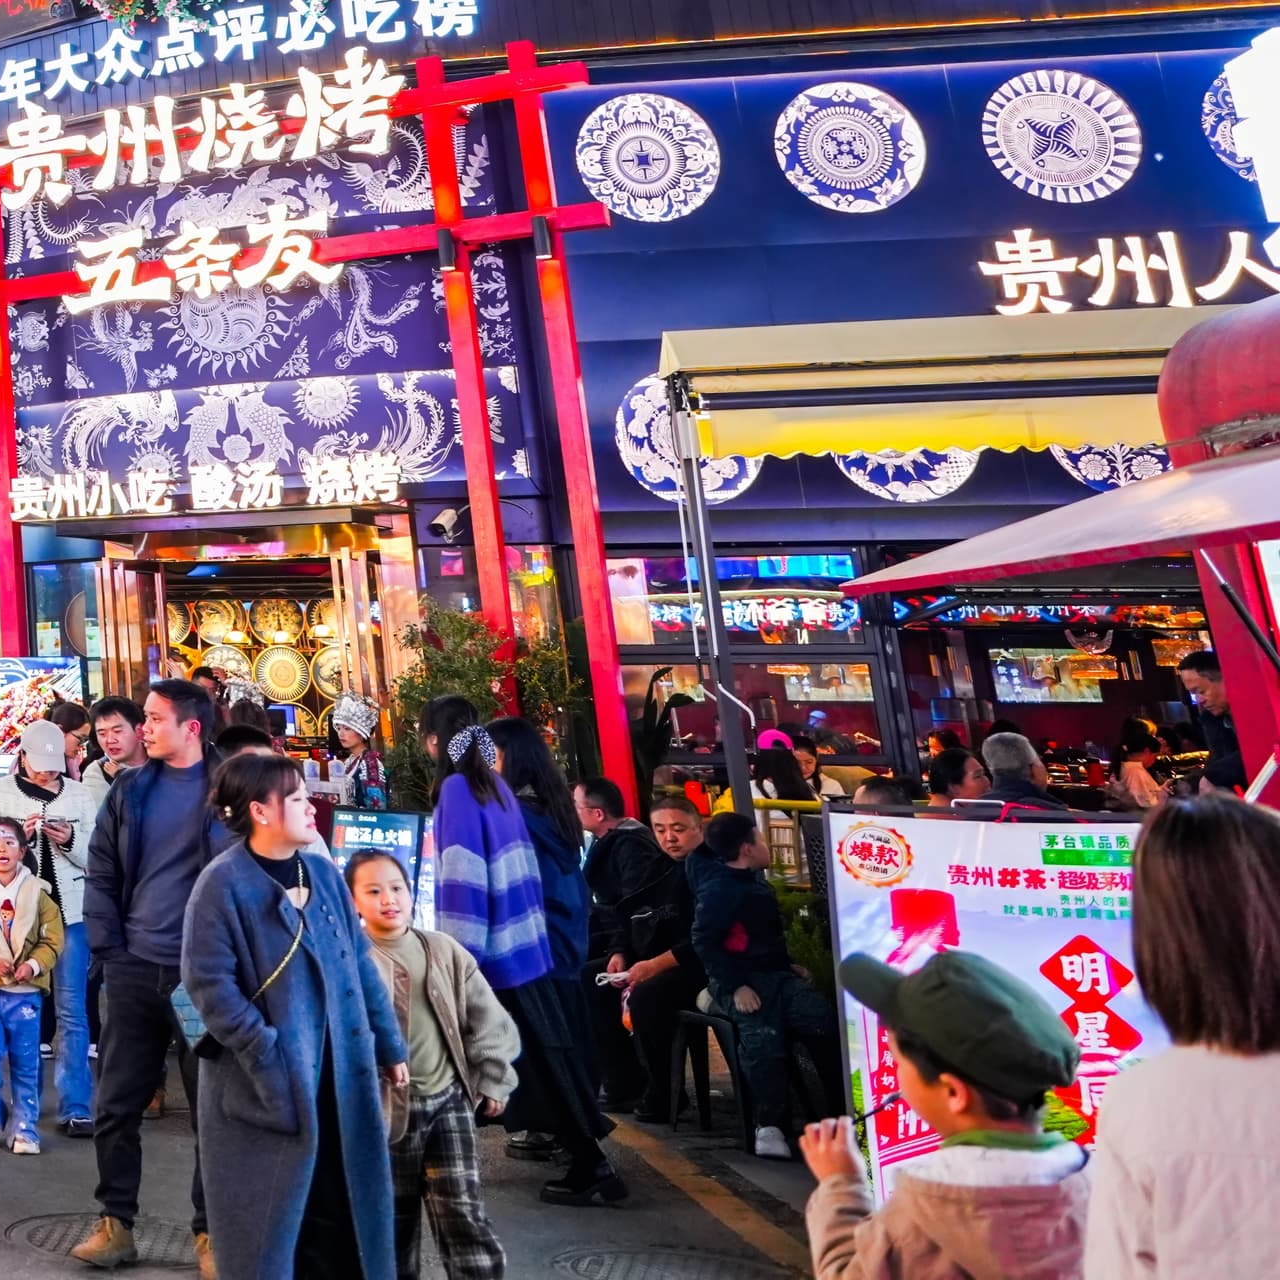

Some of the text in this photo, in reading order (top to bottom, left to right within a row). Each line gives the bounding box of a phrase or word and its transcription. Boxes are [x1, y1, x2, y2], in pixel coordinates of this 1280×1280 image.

[62, 205, 343, 317] 五条友
[9, 453, 403, 522] 贵州小吃 酸汤 烧烤
[344, 825, 413, 847] 酸汤鱼火锅
[1044, 834, 1131, 850] 茅台镇品质
[848, 839, 900, 868] 爆款
